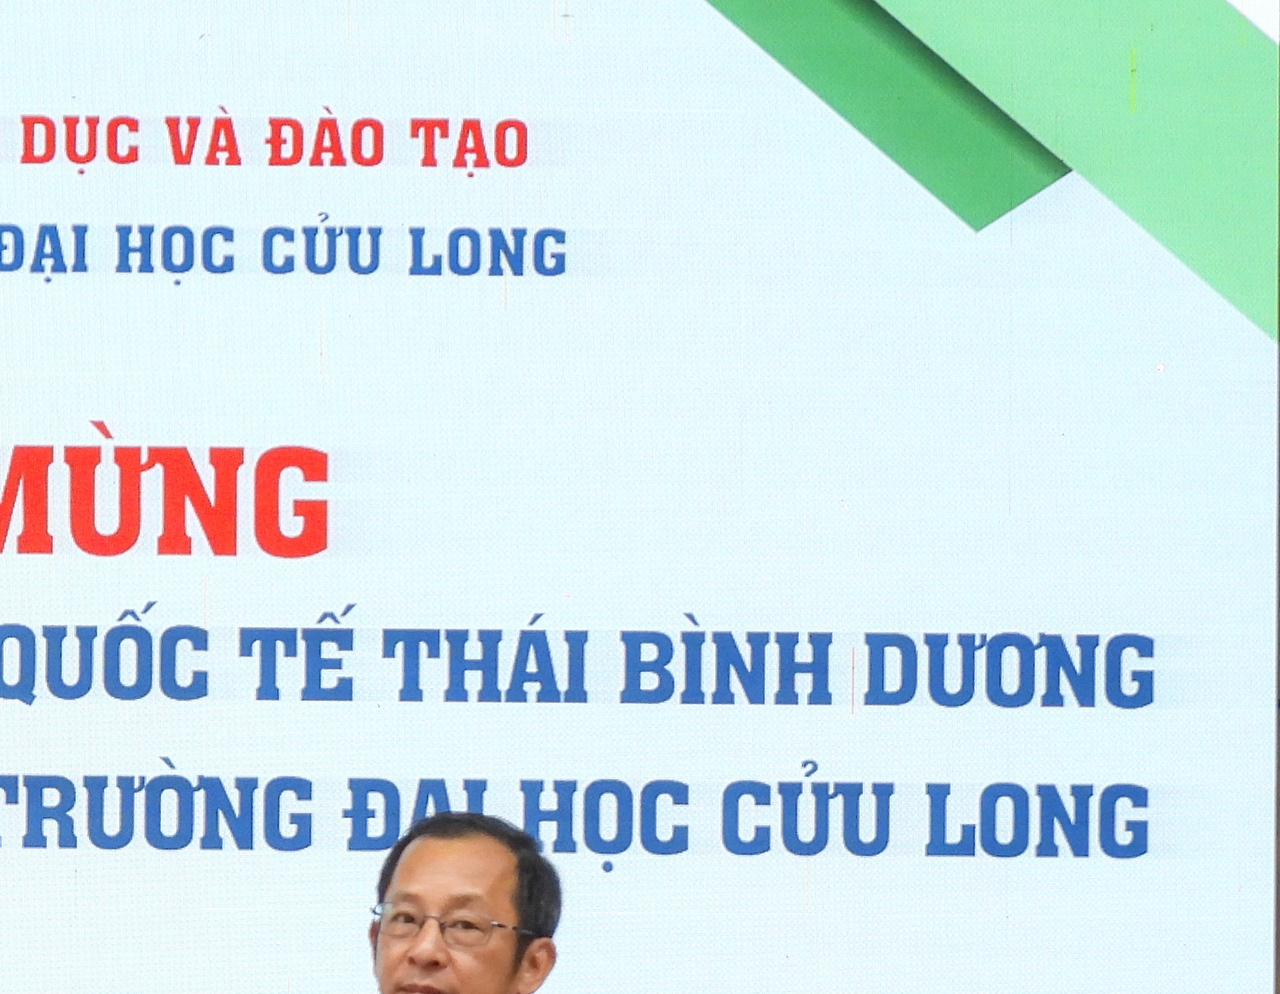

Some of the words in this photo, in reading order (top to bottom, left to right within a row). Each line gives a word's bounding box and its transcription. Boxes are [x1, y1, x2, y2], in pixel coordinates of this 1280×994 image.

[21, 115, 140, 175] DỤC
[165, 107, 242, 167] VÀ
[265, 107, 385, 167] ĐÀO
[410, 117, 528, 178] TẠO
[116, 224, 235, 286] HỌC
[262, 211, 383, 275] CỬU
[409, 226, 568, 277] LONG
[240, 603, 356, 702] TẾ
[382, 612, 589, 703] THÁI
[620, 612, 833, 705] BÌNH
[864, 631, 1156, 710] DƯƠNG
[520, 779, 690, 873] HỌC
[722, 760, 895, 857] CỬU
[925, 782, 1150, 859] LONG
